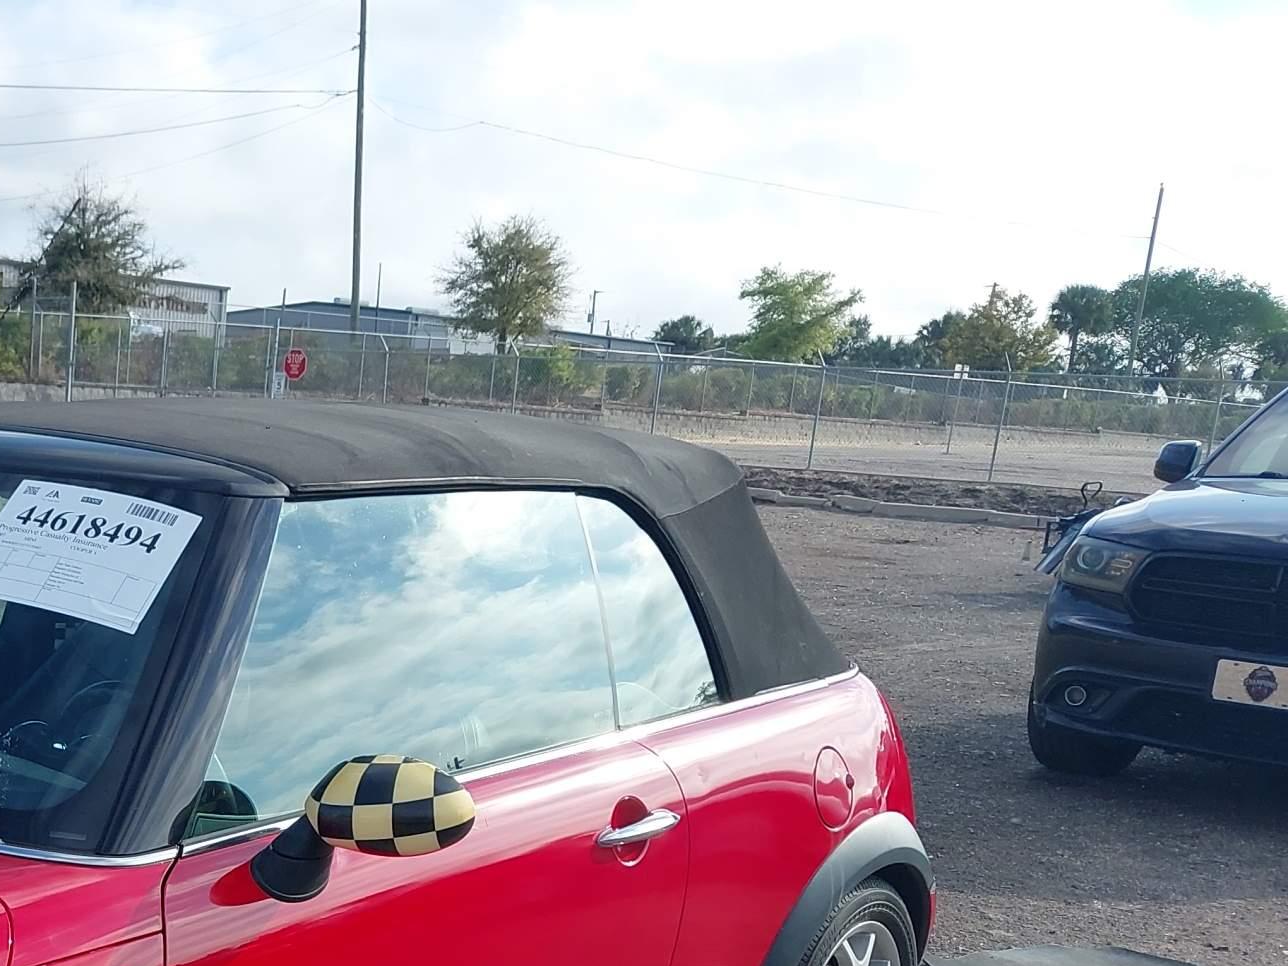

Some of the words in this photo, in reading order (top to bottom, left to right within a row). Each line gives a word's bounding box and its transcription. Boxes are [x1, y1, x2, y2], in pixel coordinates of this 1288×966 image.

[287, 353, 304, 363] STOP
[15, 505, 162, 553] 44618494
[40, 530, 69, 543] Casualty
[72, 536, 109, 550] Insurance
